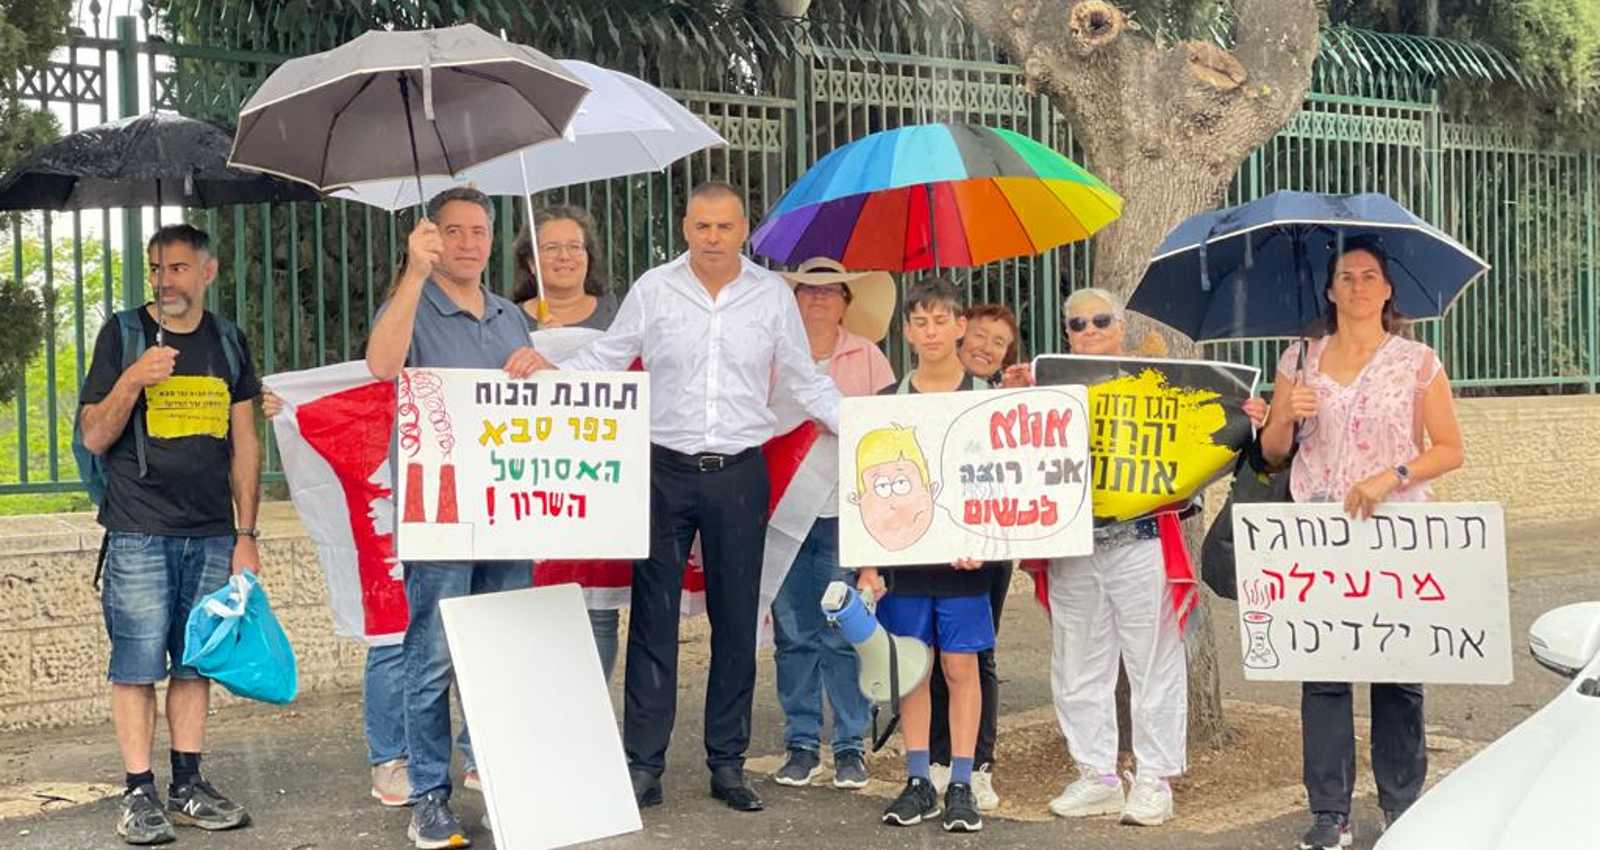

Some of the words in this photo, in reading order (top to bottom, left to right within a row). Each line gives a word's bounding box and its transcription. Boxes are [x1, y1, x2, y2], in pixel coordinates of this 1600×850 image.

[476, 382, 538, 406] הכוח
[551, 382, 638, 409] תחנת
[1096, 393, 1136, 417] הזה
[1144, 395, 1179, 419] הגז
[479, 416, 553, 446] סבא
[567, 416, 618, 442] כפר
[960, 461, 1022, 483] רוצה
[1038, 459, 1084, 485] אני
[964, 495, 1058, 526] לנשום
[1262, 563, 1446, 602] מרעילה
[1287, 613, 1411, 653] ילדינו
[1429, 625, 1486, 659] את
